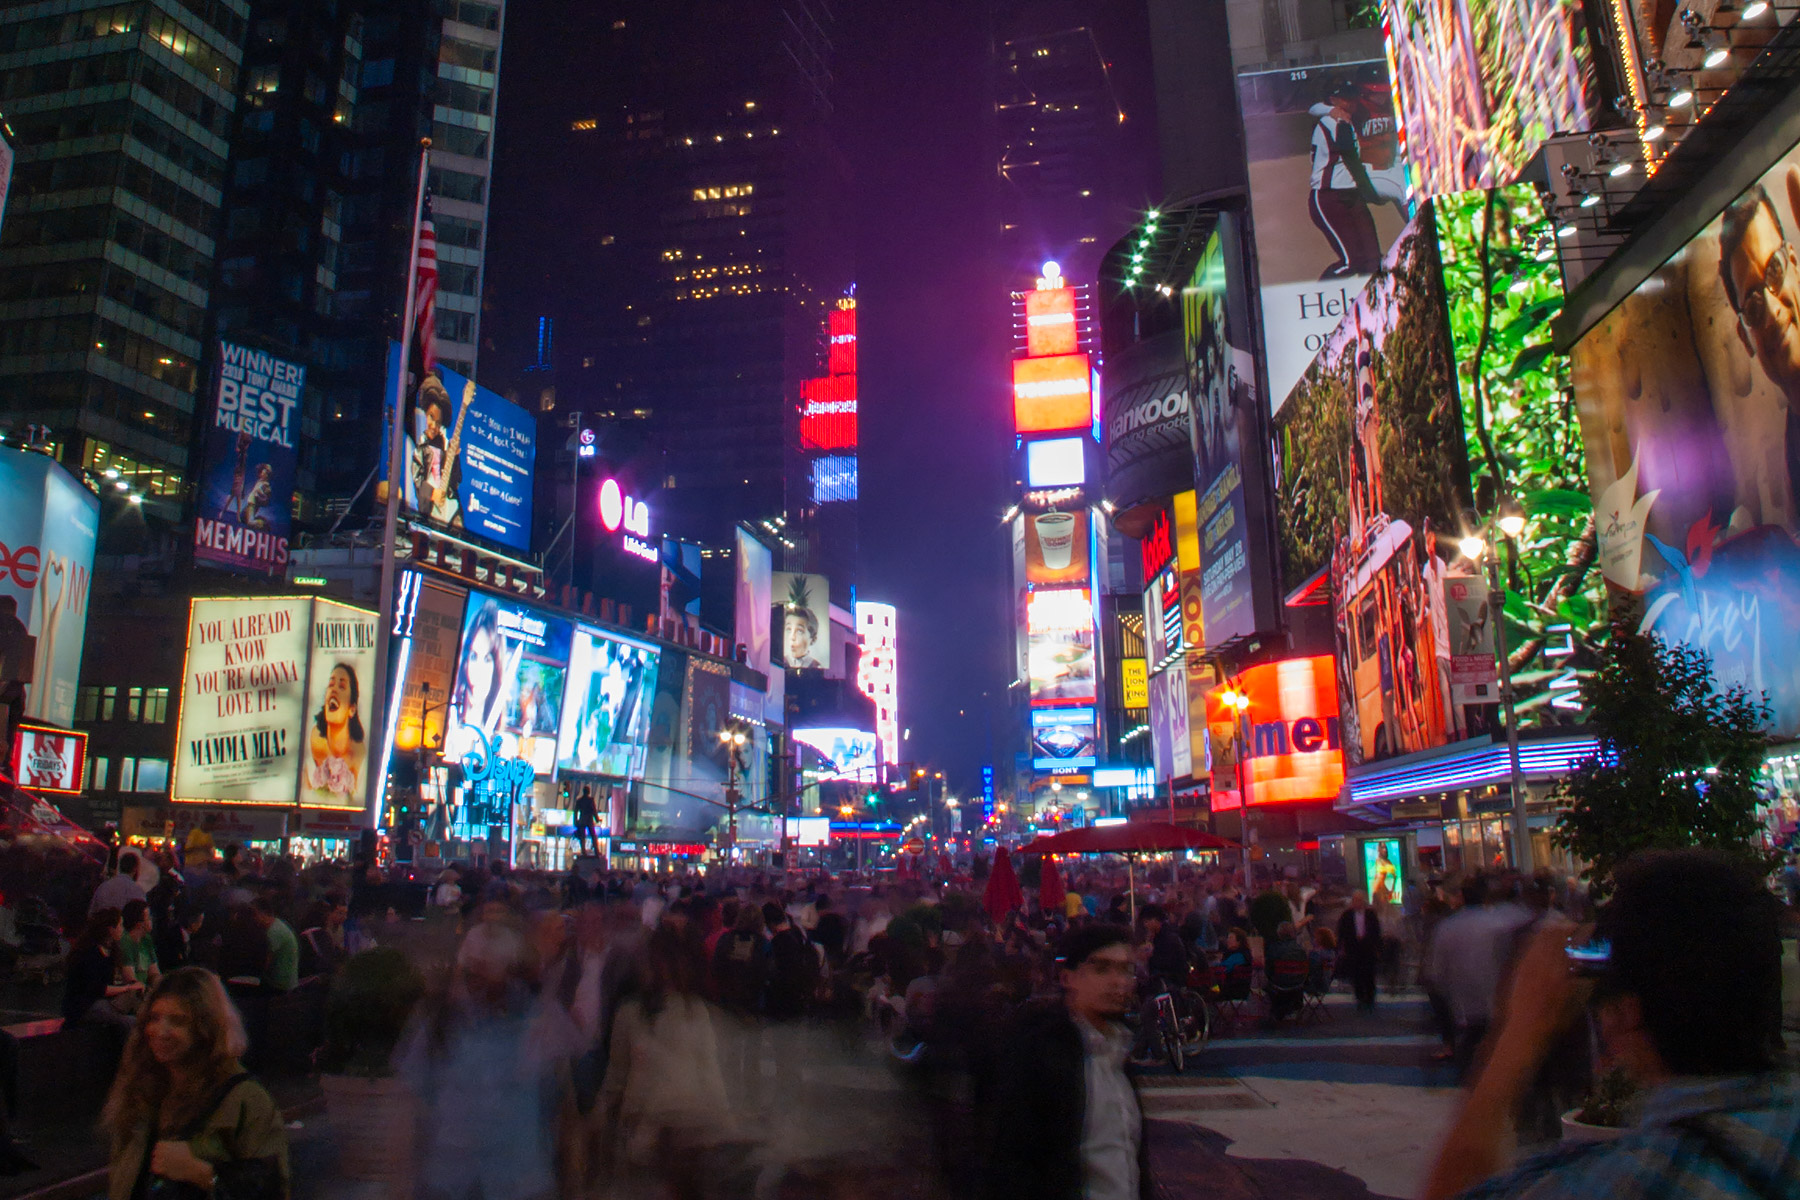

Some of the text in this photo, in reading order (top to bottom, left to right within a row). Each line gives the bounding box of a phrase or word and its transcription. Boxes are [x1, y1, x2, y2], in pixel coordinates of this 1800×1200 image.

[1290, 71, 1307, 80] 215
[1362, 117, 1389, 136] WEST
[1297, 288, 1355, 320] Hel
[221, 340, 302, 386] WINNER!
[247, 370, 270, 389] TONY
[218, 378, 296, 428] BEST
[216, 409, 293, 448] MUSICAL
[624, 495, 649, 537] LG
[195, 517, 289, 564] MEMPHIS
[1142, 510, 1172, 585] Kodak
[199, 609, 293, 644] YOU ALREADY
[315, 622, 374, 648] MAMMA MIA!
[225, 638, 267, 666] KNOW
[195, 660, 298, 695] YOU'RE GONNA
[1126, 677, 1144, 688] LION
[1128, 668, 1141, 676] THE
[217, 687, 276, 718] LOVE IT!
[1126, 690, 1146, 702] KING
[191, 728, 287, 767] MAMMA MIA!
